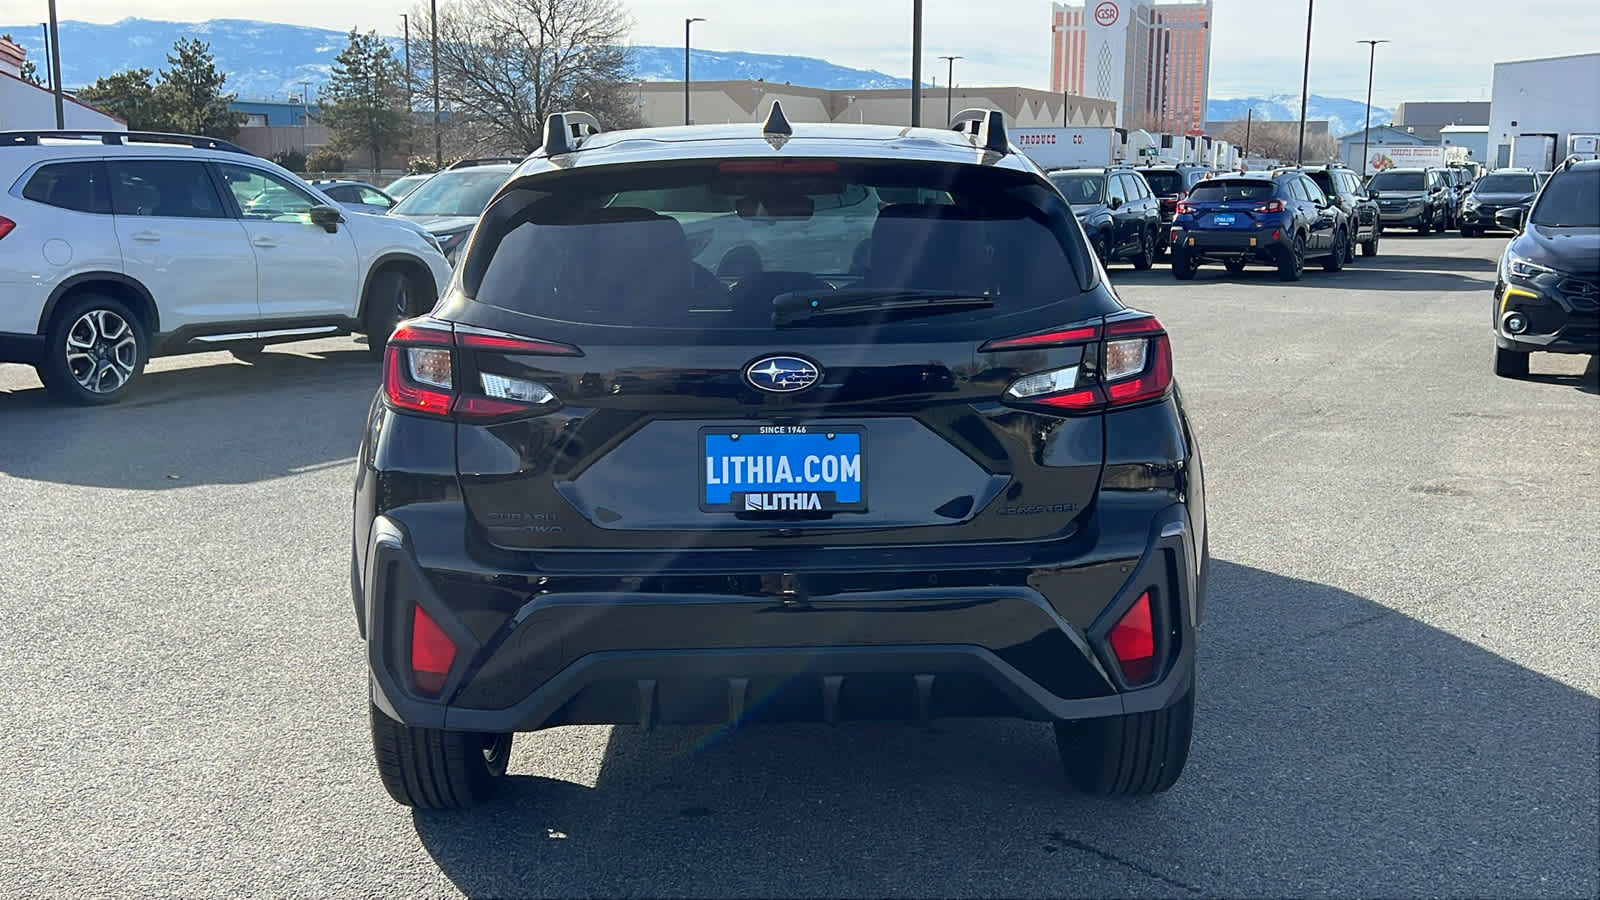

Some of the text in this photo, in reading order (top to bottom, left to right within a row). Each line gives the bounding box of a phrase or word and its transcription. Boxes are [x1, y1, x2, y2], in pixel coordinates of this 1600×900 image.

[1097, 8, 1115, 19] GSR
[1020, 134, 1085, 145] PRODUCE CO.
[759, 426, 807, 434] SINCE 1946
[706, 454, 861, 485] LITHIA.COM
[762, 493, 823, 510] LITHIA
